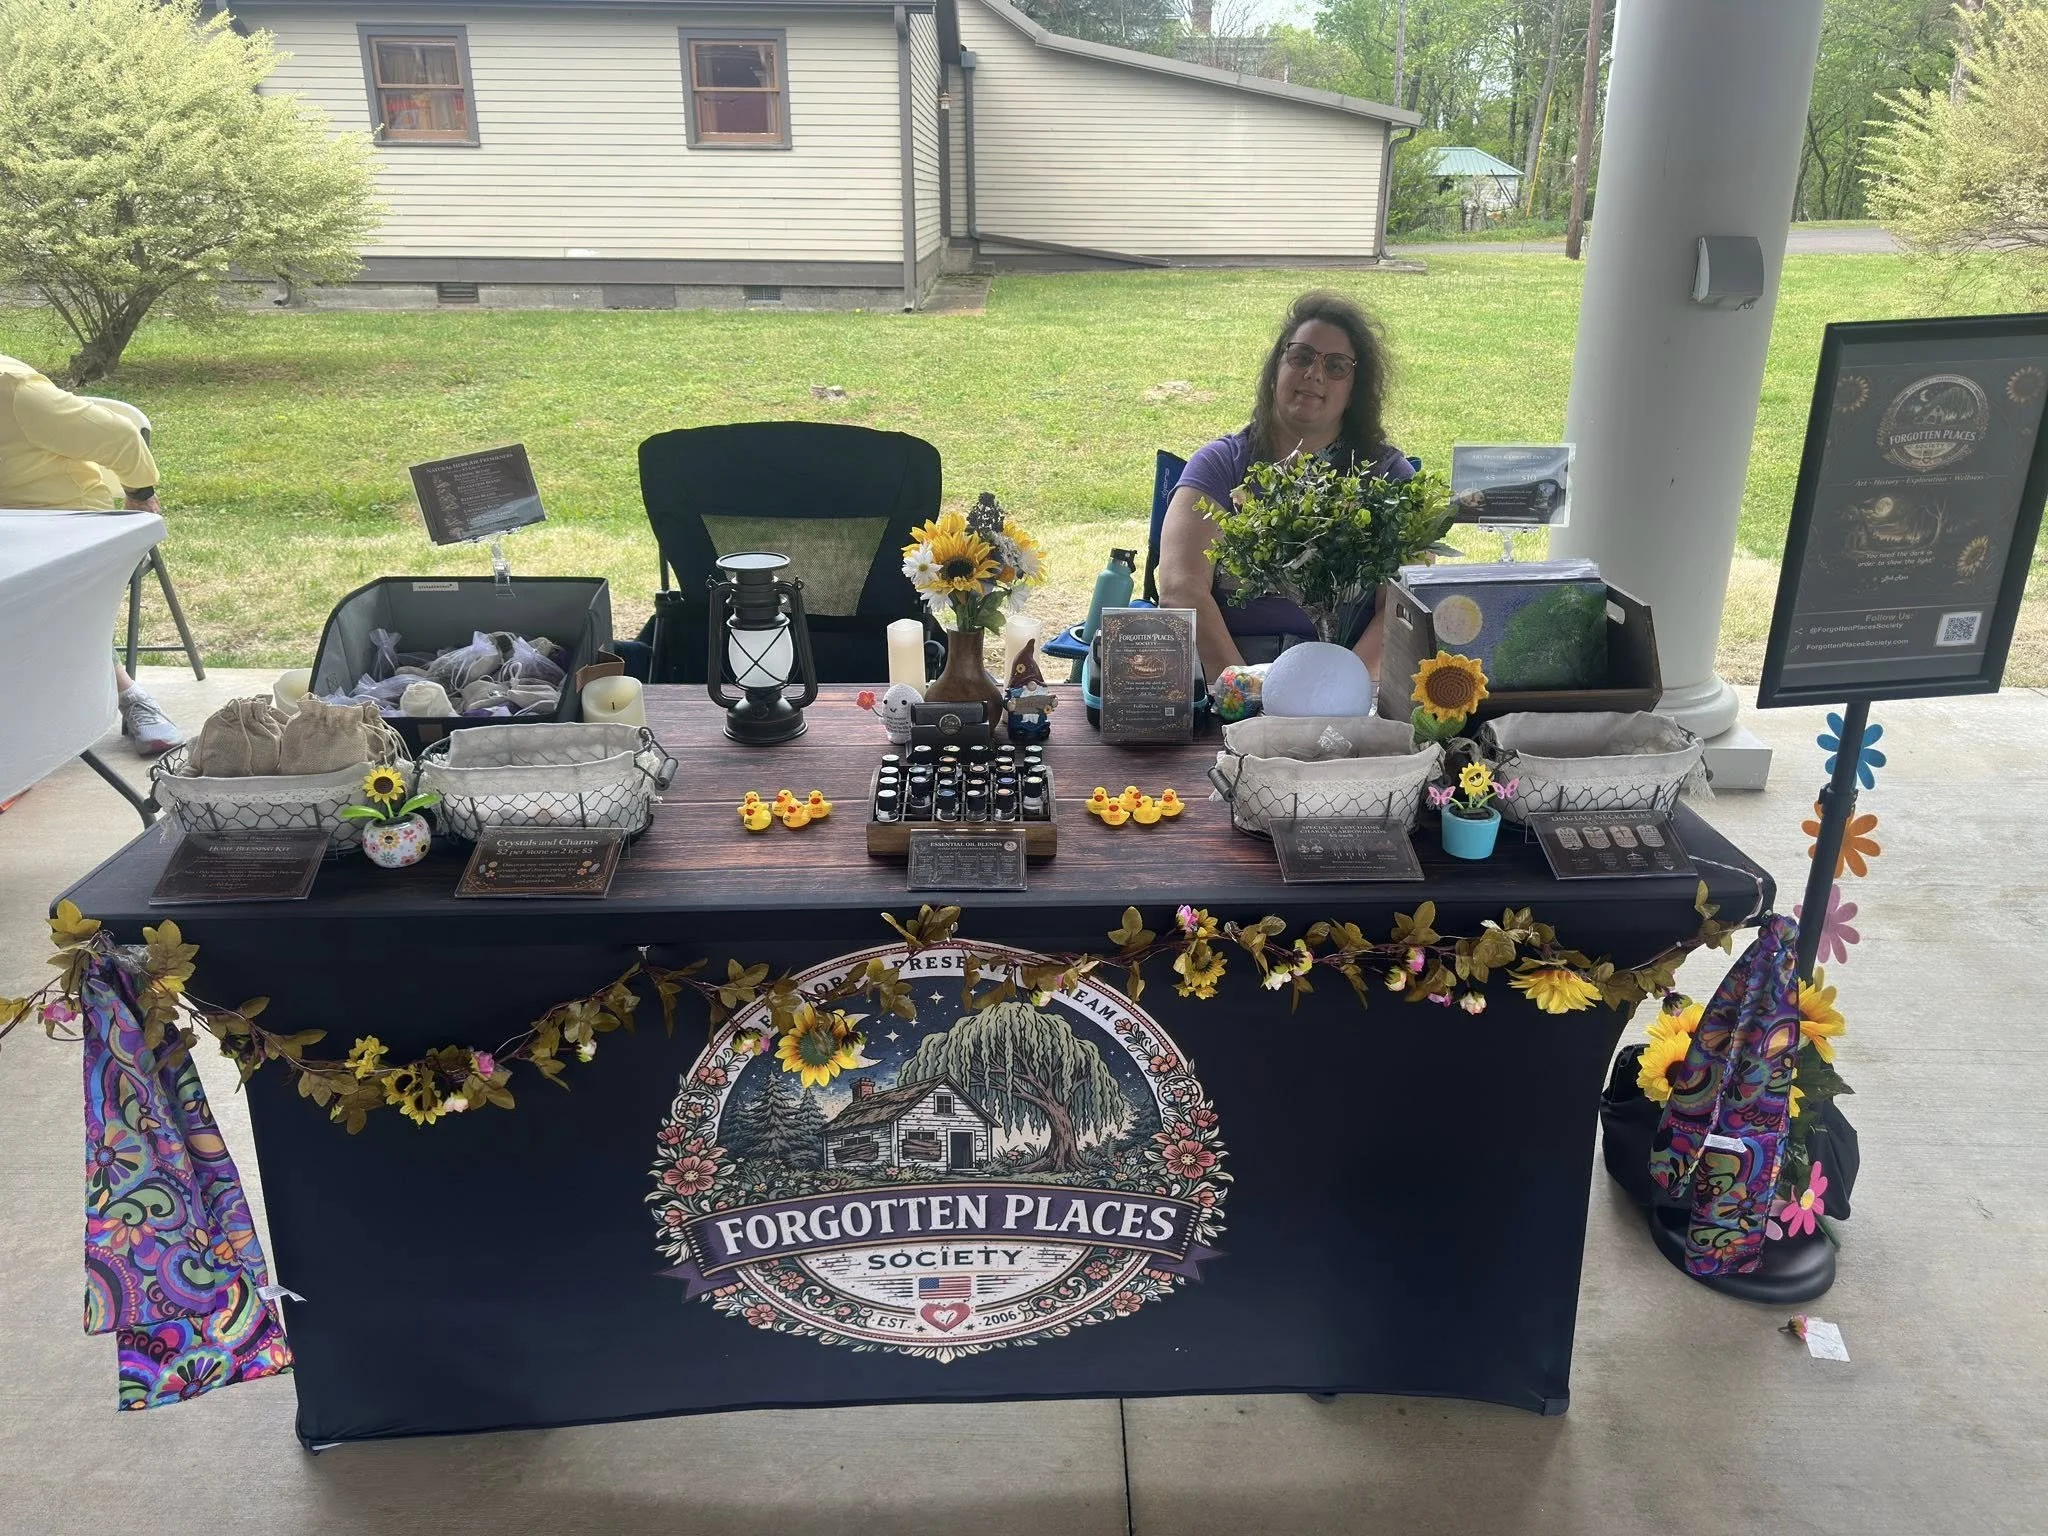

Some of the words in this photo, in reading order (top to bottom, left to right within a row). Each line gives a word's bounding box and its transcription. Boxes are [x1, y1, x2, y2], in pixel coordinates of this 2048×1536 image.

[1889, 430, 1941, 445] FORGOTTEN
[1942, 430, 1977, 441] PLACES
[1873, 479, 1899, 488] History
[1905, 476, 1948, 485] Exploration
[1865, 614, 1896, 622] Follow
[1809, 622, 1904, 635] @ForgottenPlacesSociety
[1118, 633, 1151, 642] FORGOTTEN
[1151, 633, 1175, 642] PLACES
[1806, 639, 1909, 651] ForgottenPlacesSociety.com
[496, 839, 538, 849] Crystals
[558, 838, 599, 846] Charms
[715, 1194, 990, 1256] FORGOTTEN
[1003, 1193, 1178, 1242] PLACES
[867, 1249, 1024, 1270] SOCIETY
[983, 1310, 1018, 1327] 2006
